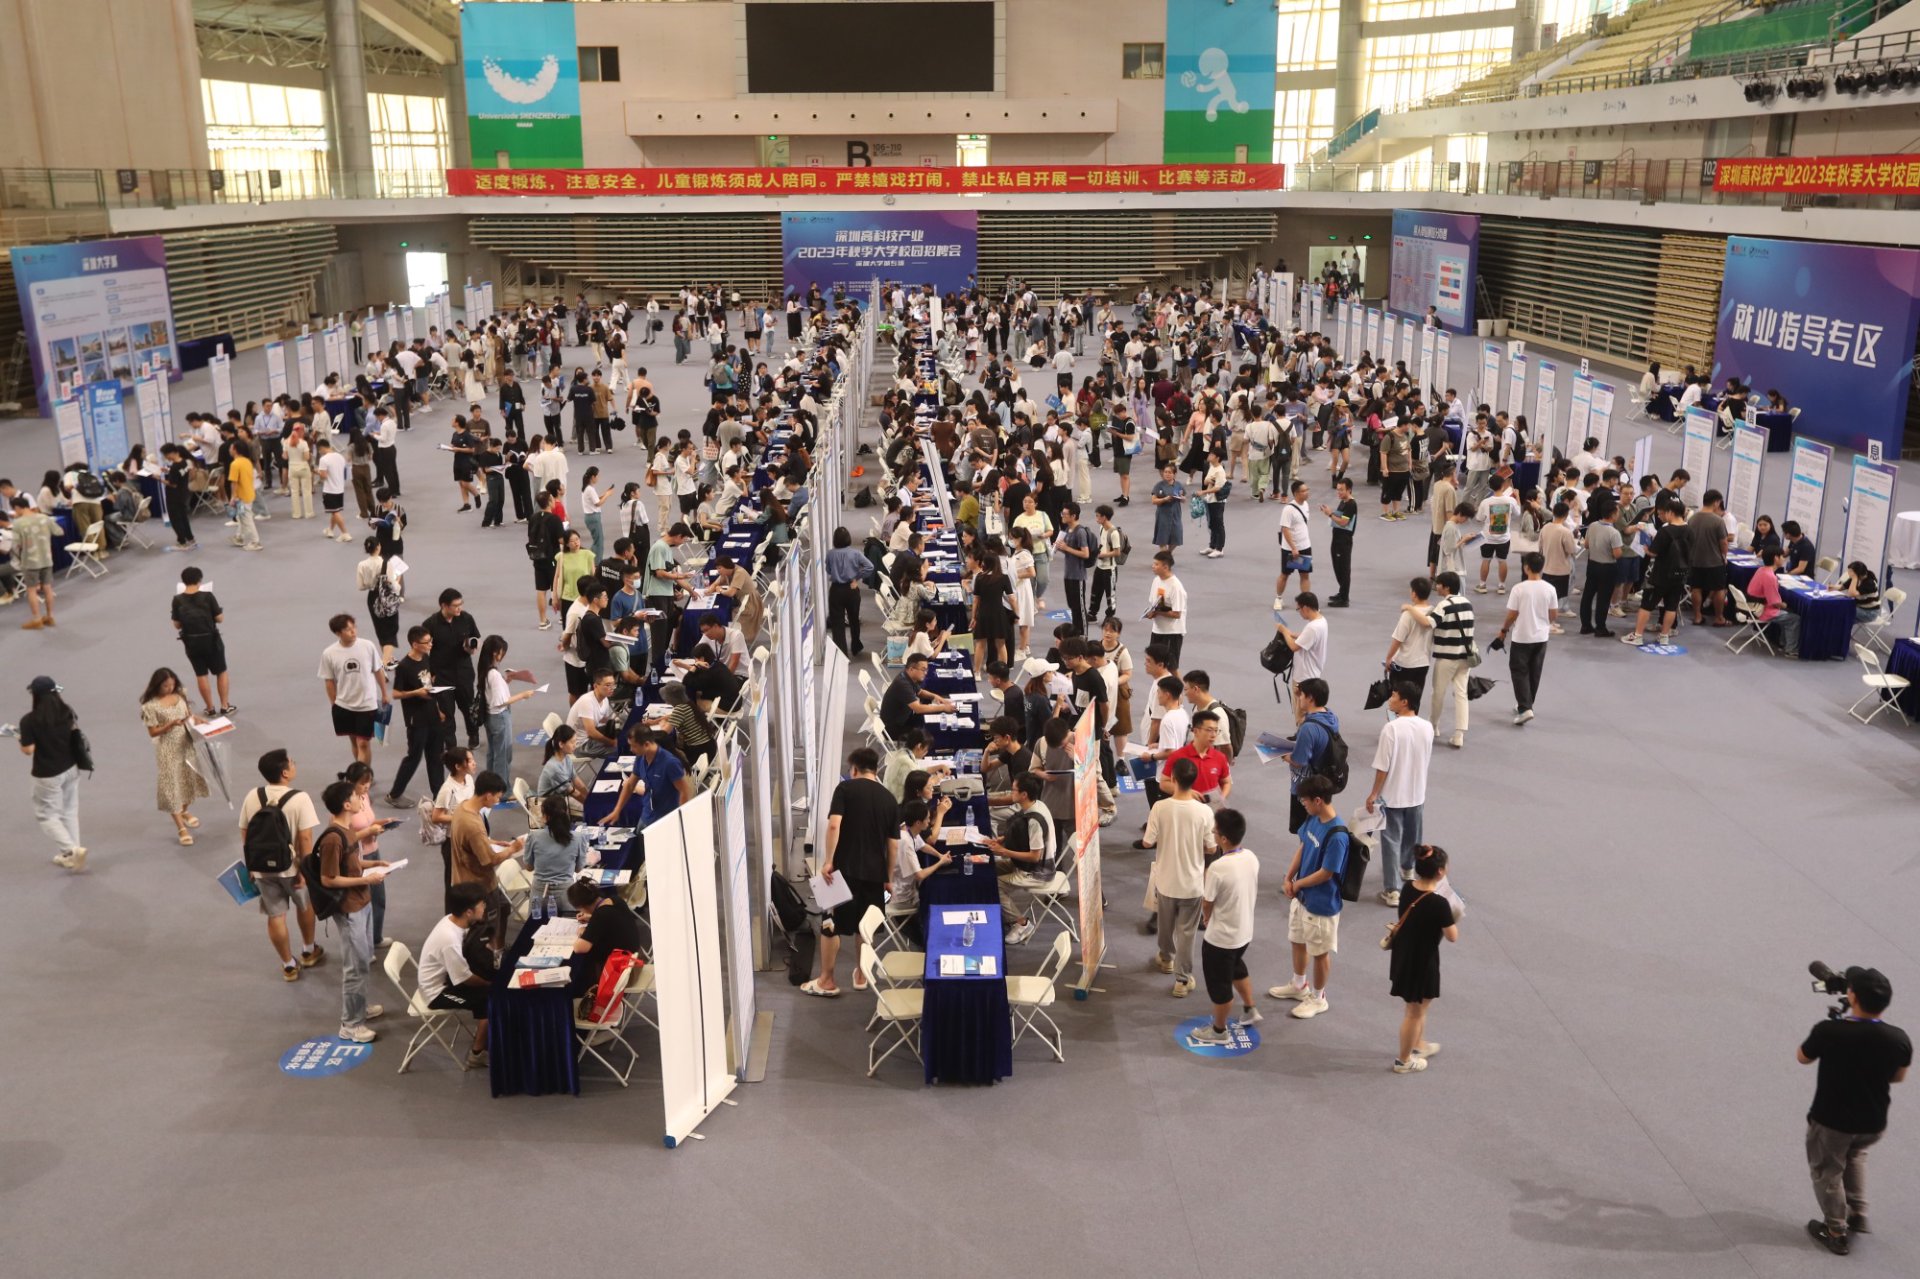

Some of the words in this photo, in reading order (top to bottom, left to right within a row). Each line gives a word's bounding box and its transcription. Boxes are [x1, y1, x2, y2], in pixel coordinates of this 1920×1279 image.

[847, 140, 872, 167] B
[1703, 160, 1718, 176] 102
[835, 230, 924, 243] 深圳高科技产业
[798, 244, 962, 259] 2023年秋季大学校园招聘会
[1732, 303, 1884, 368] 就业指导专区
